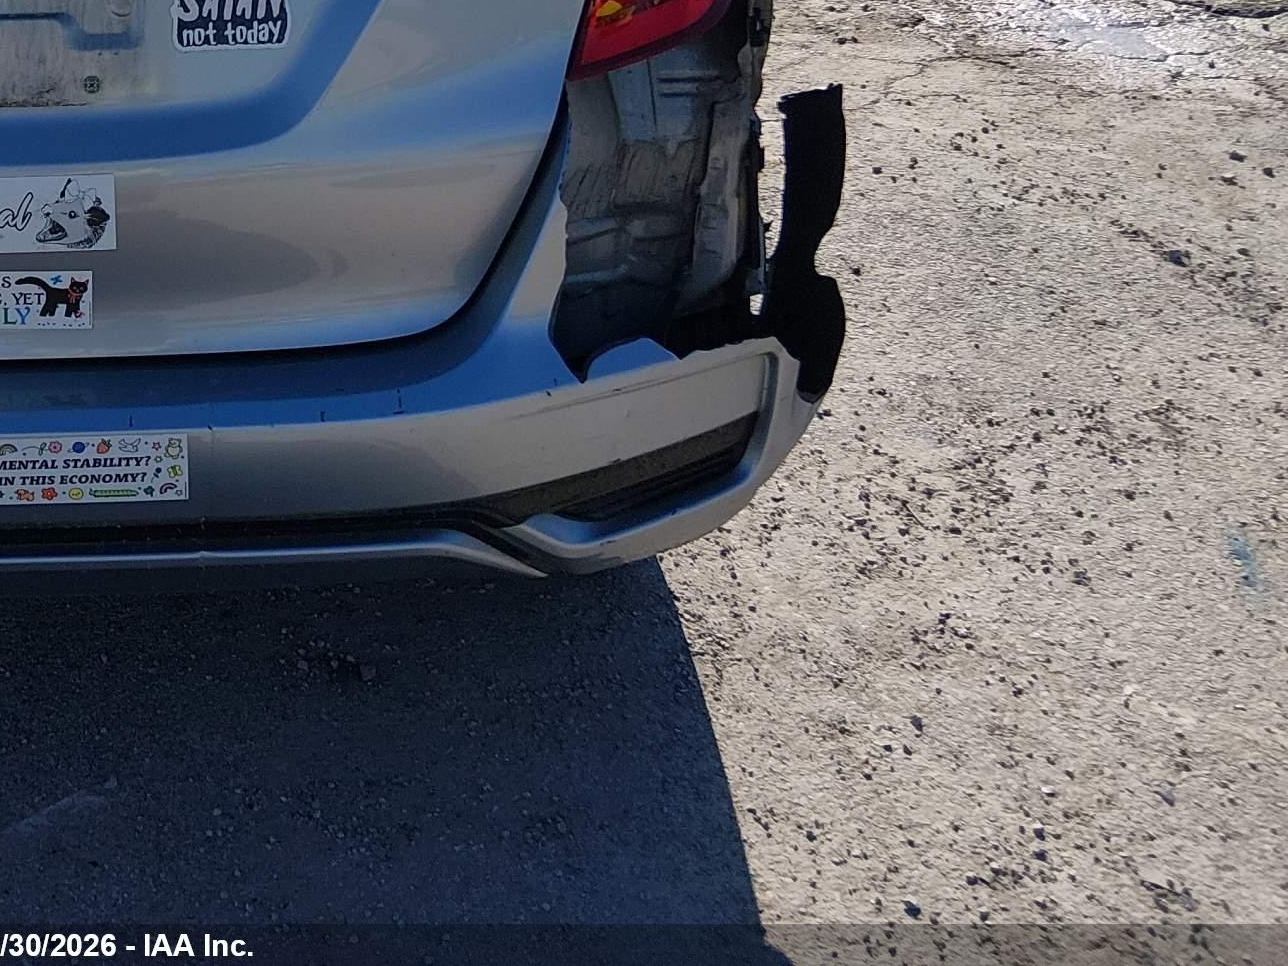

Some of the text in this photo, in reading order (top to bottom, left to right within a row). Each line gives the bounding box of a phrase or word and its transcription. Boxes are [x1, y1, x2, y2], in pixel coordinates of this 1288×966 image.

[182, 20, 282, 46] not today
[12, 292, 45, 306] YET
[62, 455, 152, 469] STABILITY?
[19, 474, 56, 486] THIS
[60, 472, 148, 485] ECONOMY?
